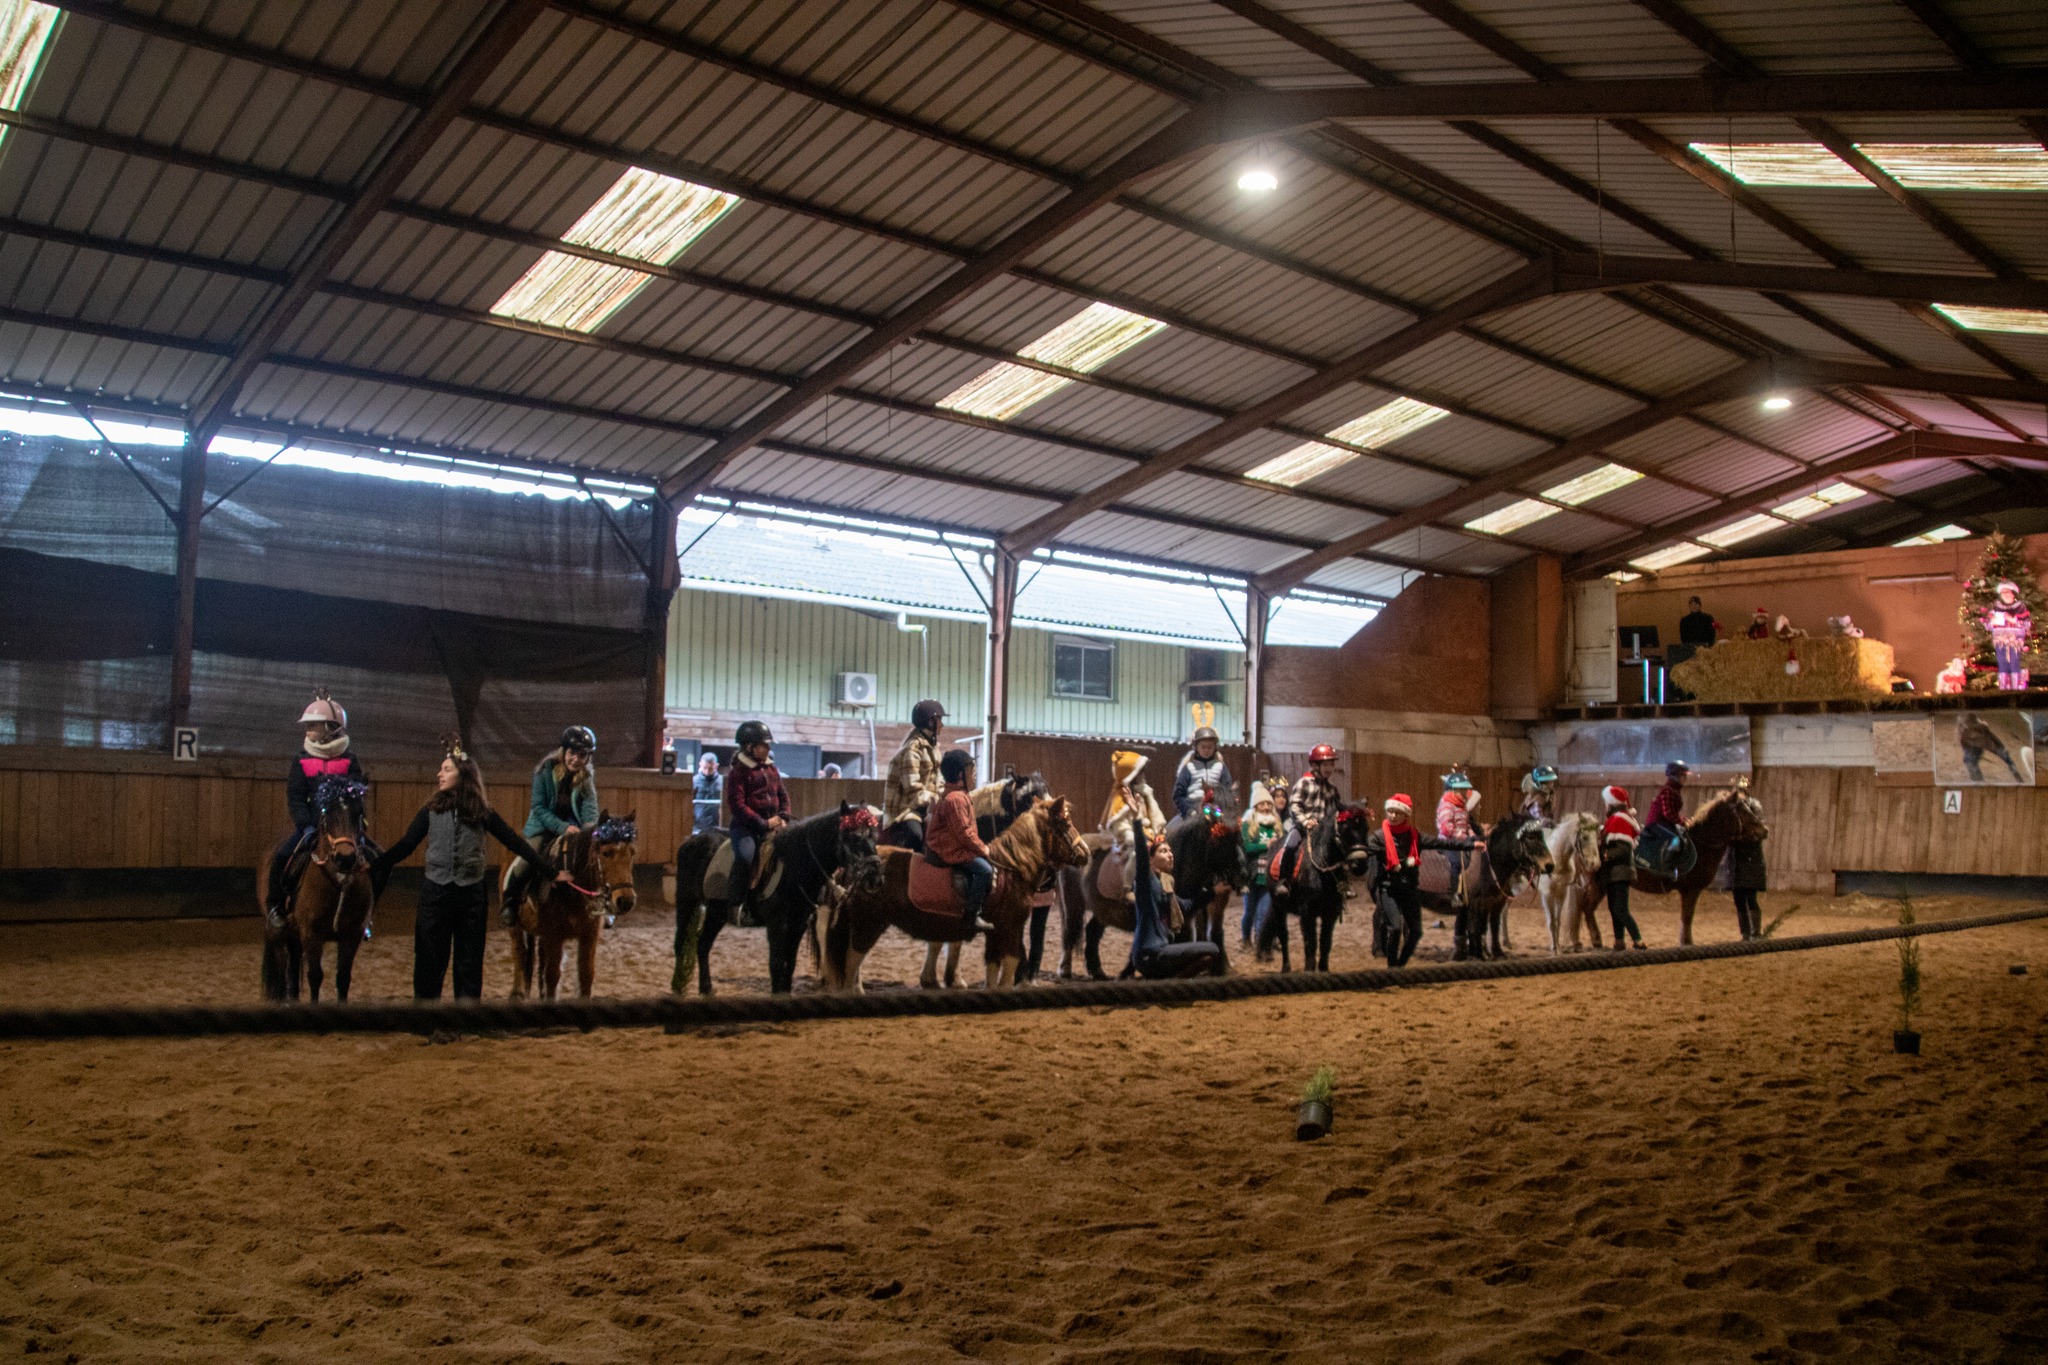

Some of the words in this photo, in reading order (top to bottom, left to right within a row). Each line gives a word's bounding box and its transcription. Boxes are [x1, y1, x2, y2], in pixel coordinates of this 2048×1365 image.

[177, 730, 196, 757] R
[662, 753, 674, 775] B
[1947, 793, 1958, 811] A
